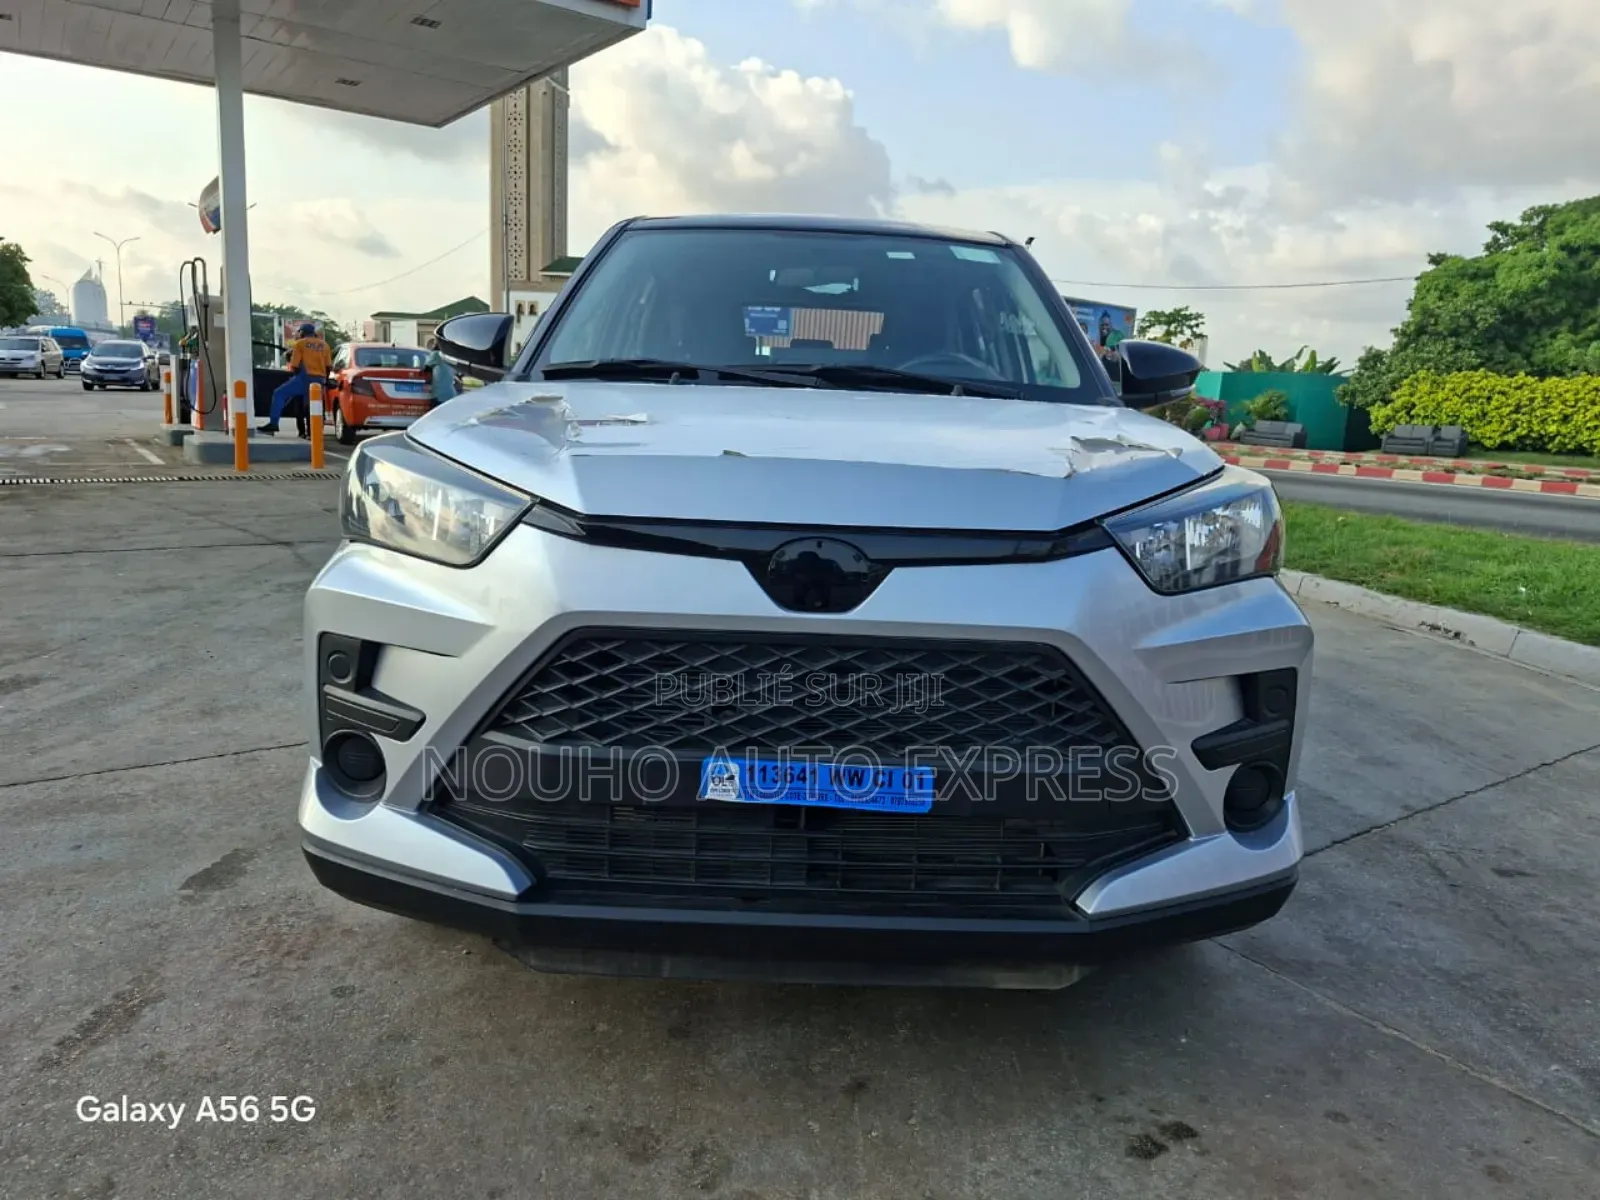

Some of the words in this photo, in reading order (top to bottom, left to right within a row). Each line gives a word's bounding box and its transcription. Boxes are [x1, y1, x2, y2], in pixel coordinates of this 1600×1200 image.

[748, 764, 818, 785] 113641
[829, 767, 865, 787] WW
[873, 769, 893, 789] CI
[902, 770, 925, 790] 01
